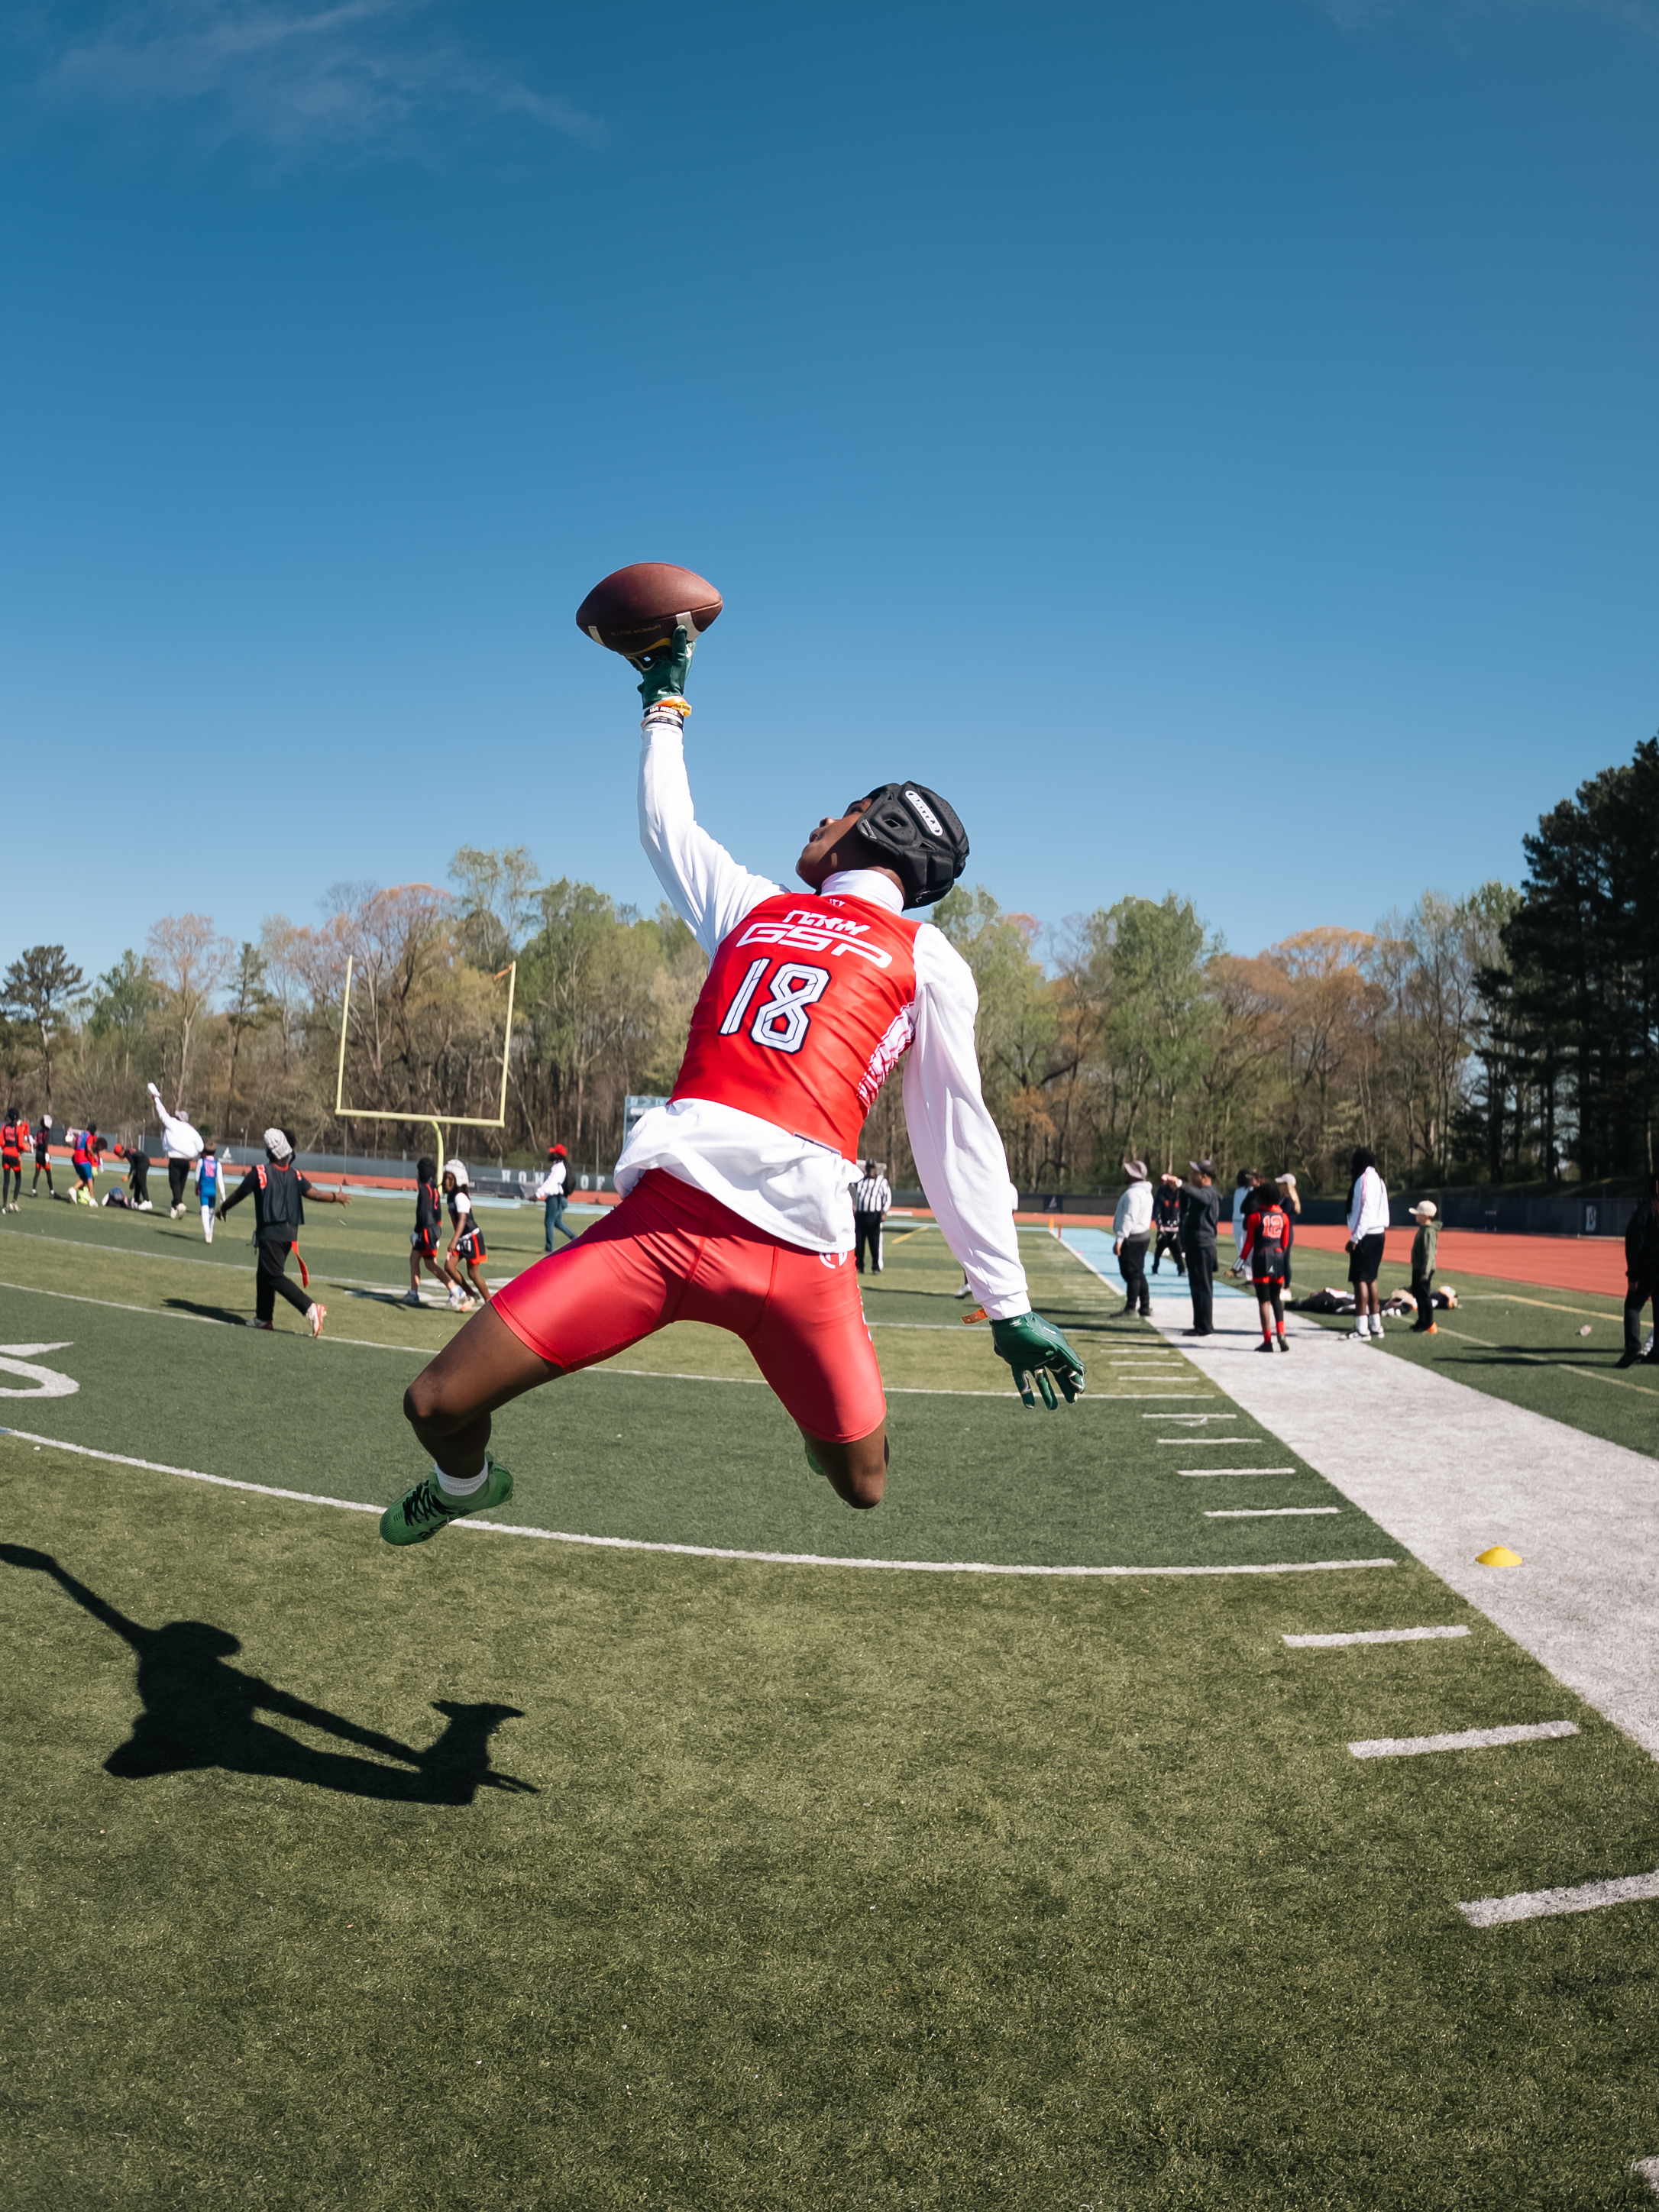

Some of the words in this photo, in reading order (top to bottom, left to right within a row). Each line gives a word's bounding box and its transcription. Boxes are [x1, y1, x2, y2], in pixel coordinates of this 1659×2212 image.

[782, 910, 871, 936] TEAM
[736, 922, 893, 969] GSP
[718, 957, 832, 1054] 18
[501, 1169, 545, 1186] HOM
[580, 1174, 606, 1191] OF
[1262, 1214, 1284, 1238] 12
